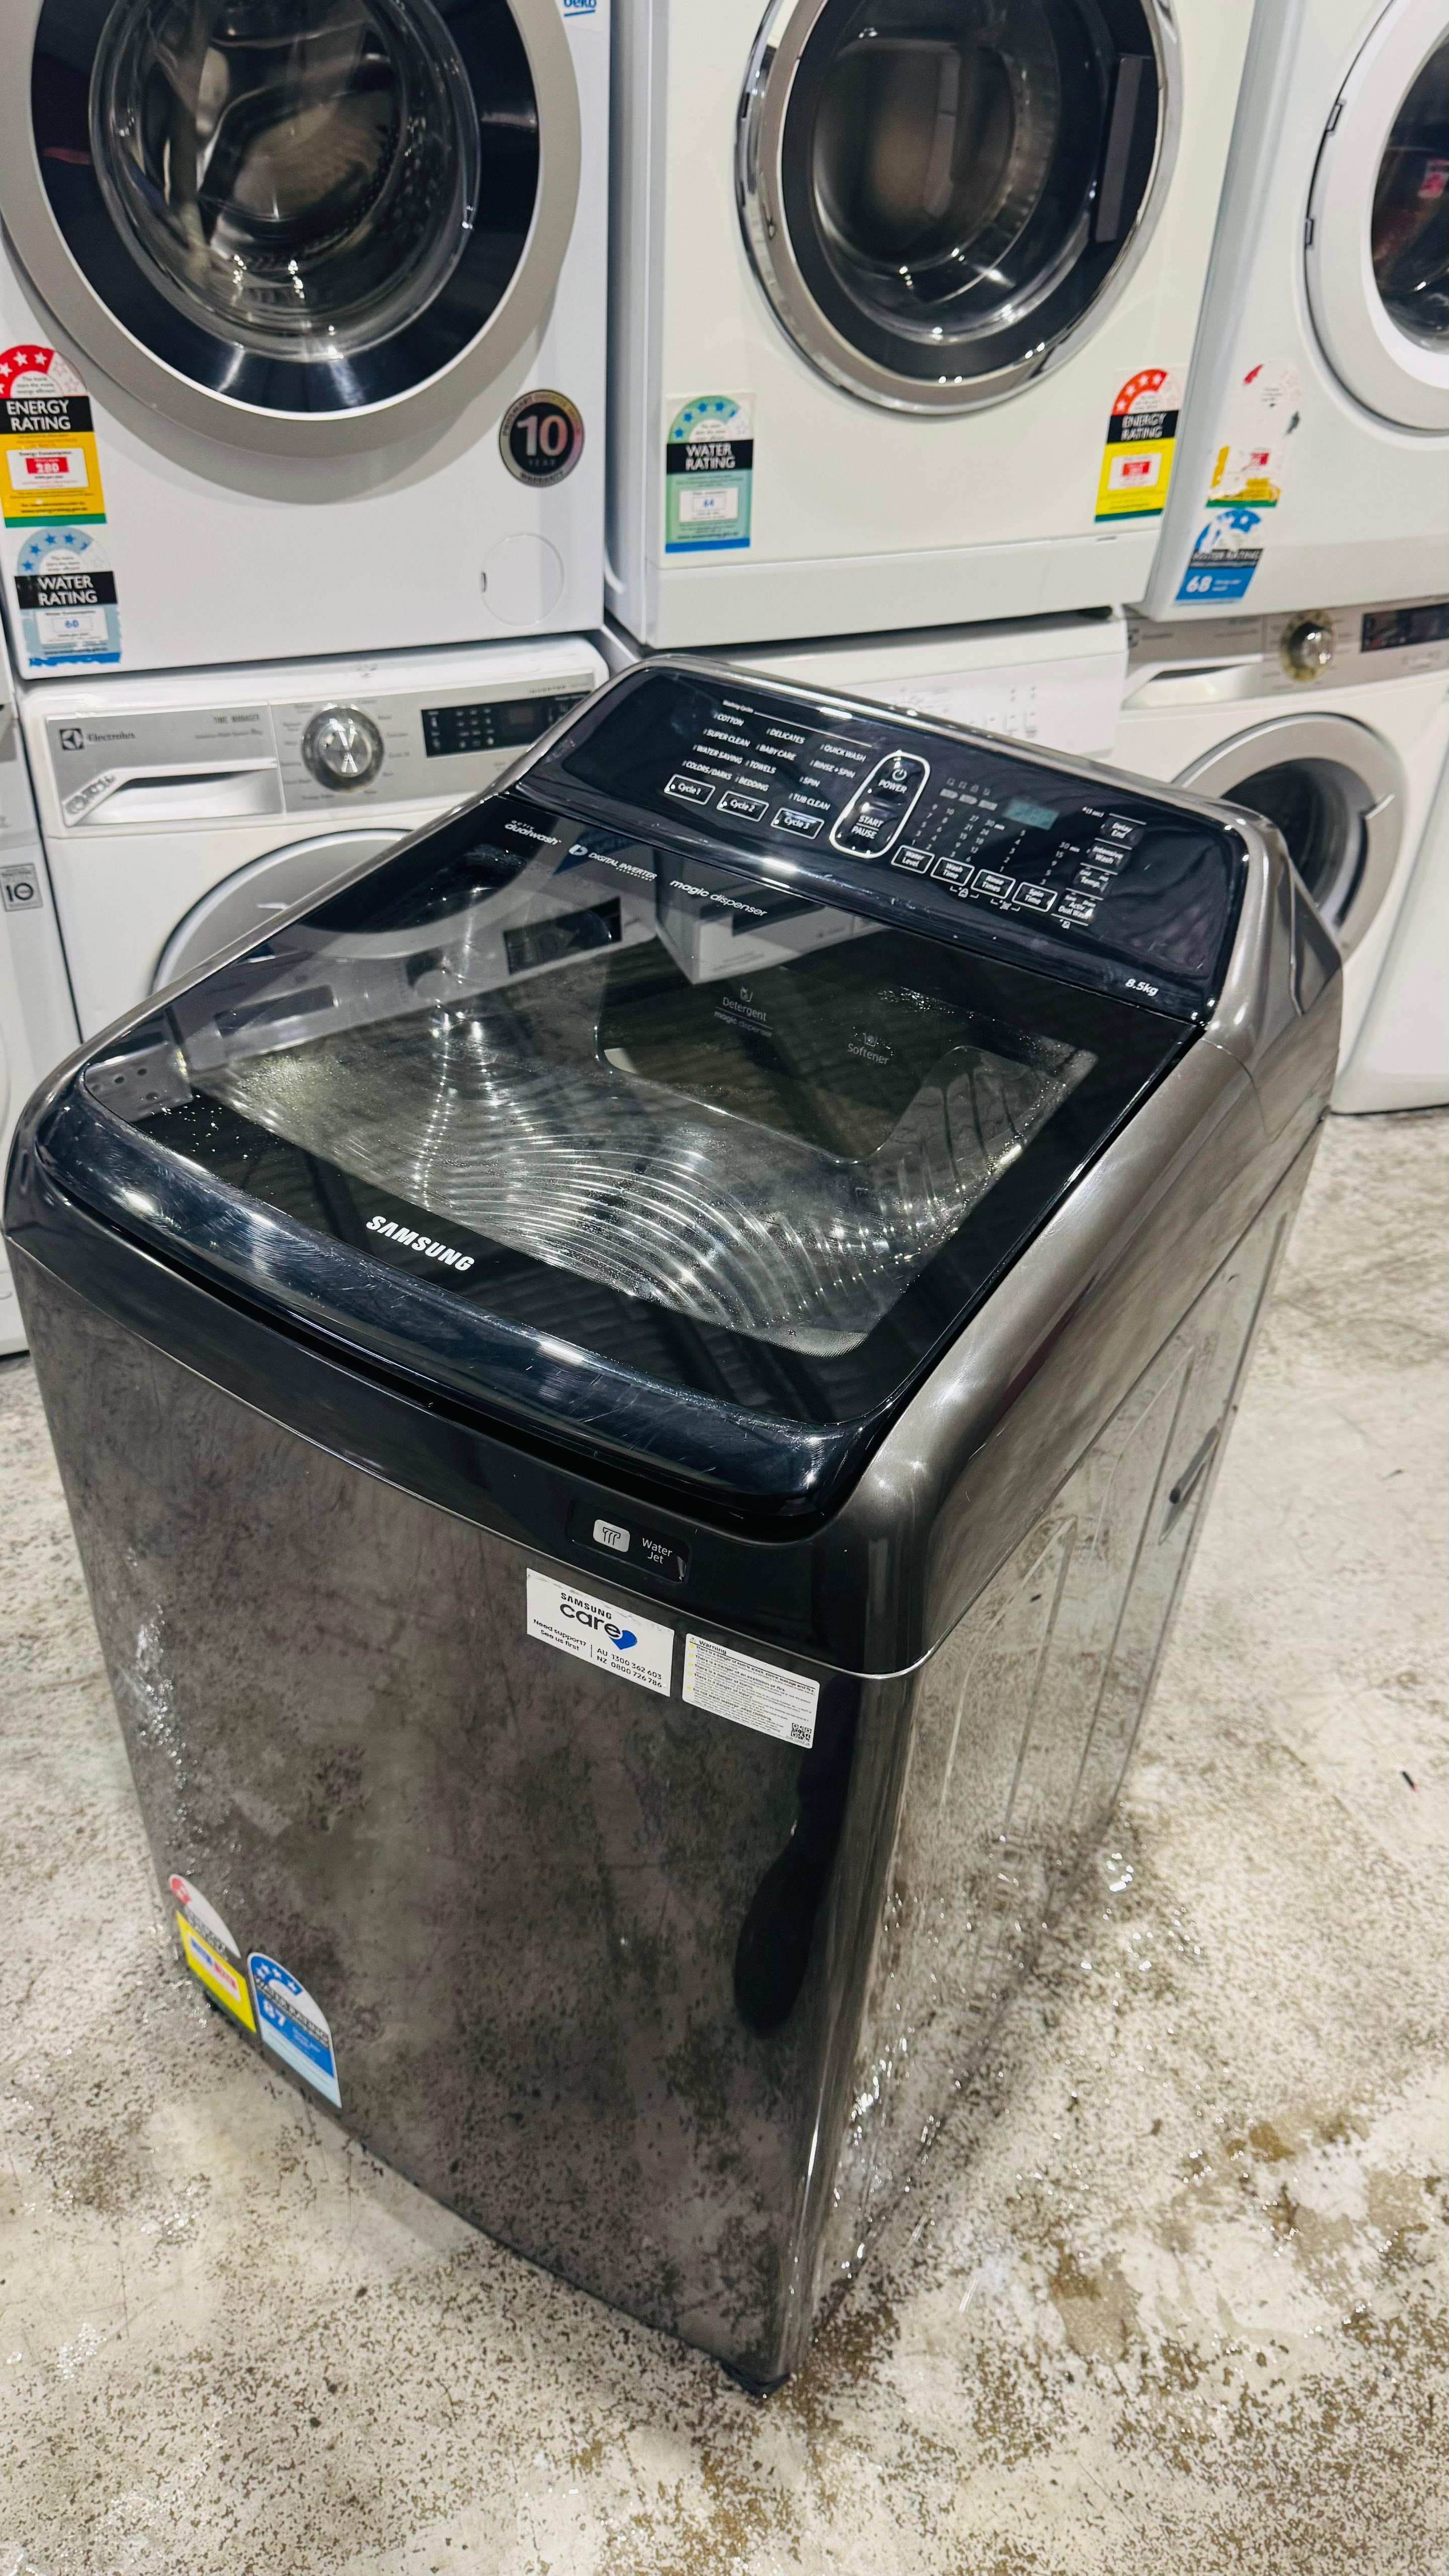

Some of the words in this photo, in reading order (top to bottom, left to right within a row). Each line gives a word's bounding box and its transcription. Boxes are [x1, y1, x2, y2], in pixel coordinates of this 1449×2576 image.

[6, 399, 69, 416] ENERGY
[11, 417, 71, 432] RATING
[1121, 413, 1167, 429] ENERGY
[516, 415, 568, 457] 10
[1120, 427, 1163, 441] RATING
[686, 443, 733, 457] WATER
[685, 456, 736, 471] RATING
[37, 575, 94, 591] WATER
[1185, 576, 1213, 593] 68
[38, 590, 98, 606] RATING
[716, 713, 744, 727] COTTON
[87, 732, 135, 744] Electrolux
[706, 729, 729, 741] SUPER
[728, 735, 751, 748] CLEAN
[769, 728, 806, 745] DELICATES
[697, 745, 718, 757] WATER
[717, 751, 744, 765] SAVING
[759, 744, 779, 756] BABY
[777, 750, 797, 761] CARE
[823, 744, 846, 756] QUICK
[844, 749, 866, 762] WASH
[749, 760, 777, 774] TOWELS
[813, 760, 835, 772] RINSE
[837, 767, 856, 778] SPIN
[678, 783, 697, 795] Cycle
[738, 775, 769, 791] BEDDING
[802, 777, 821, 788] SPIN
[878, 779, 908, 794] POWER
[730, 799, 749, 811] Cycle
[792, 793, 808, 804] TUB
[806, 797, 831, 811] CLEAN
[783, 817, 804, 829] Cycle
[858, 815, 884, 828] START
[504, 823, 558, 845] dualwash
[851, 826, 878, 840] PAUSE
[1111, 830, 1126, 839] End
[902, 857, 920, 868] Level
[905, 851, 925, 861] Water
[1095, 853, 1115, 864] Wash
[588, 852, 619, 867] DIGITAL
[618, 863, 658, 880] INVERTER
[942, 869, 959, 879] Time
[945, 862, 963, 873] Wash
[982, 881, 1002, 893] Times
[985, 874, 1005, 886] Rinse
[1081, 876, 1101, 889] Temp.
[670, 879, 710, 898] magic
[710, 892, 768, 918] dispenser
[1024, 895, 1041, 905] Time
[1027, 888, 1045, 898] Spin
[1124, 977, 1159, 998] 8.5kg
[722, 996, 768, 1022] Detergent
[714, 1010, 738, 1026] magic
[847, 1042, 890, 1066] Softener
[366, 1216, 475, 1271] SAMSUNG
[641, 1537, 673, 1558] Water
[647, 1551, 664, 1565] Jet
[560, 1591, 612, 1620] SAMSUNG
[559, 1603, 623, 1639] care
[533, 1618, 553, 1633] Need
[554, 1628, 587, 1647] support?
[540, 1629, 554, 1640] See
[565, 1639, 580, 1651] first
[699, 1639, 727, 1655] Warning
[596, 1647, 609, 1657] AU
[610, 1653, 630, 1667] 1300
[631, 1662, 647, 1673] 362
[647, 1669, 663, 1680] 603
[695, 1654, 708, 1663] There
[596, 1654, 608, 1664] NZ
[610, 1661, 631, 1675] 0800
[632, 1671, 648, 1682] 726
[648, 1677, 664, 1689] 786
[694, 1673, 706, 1681] There
